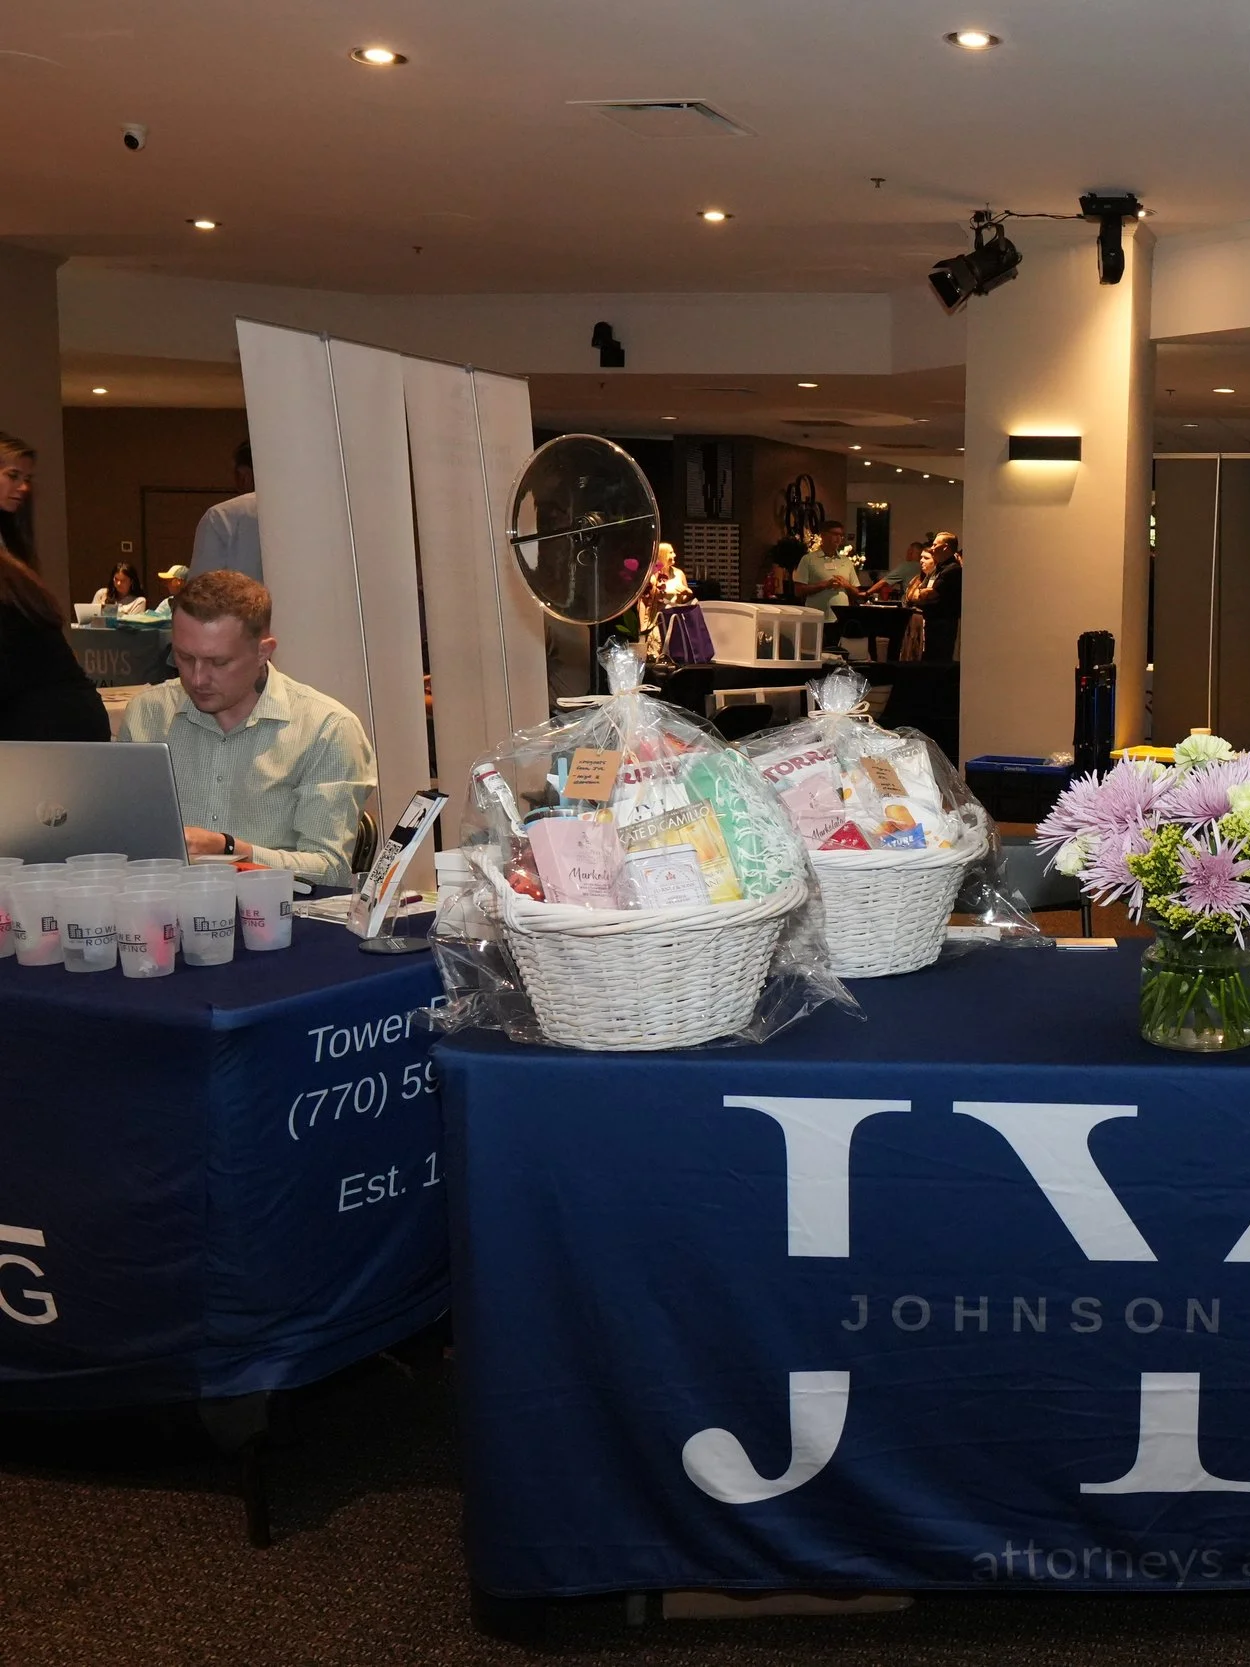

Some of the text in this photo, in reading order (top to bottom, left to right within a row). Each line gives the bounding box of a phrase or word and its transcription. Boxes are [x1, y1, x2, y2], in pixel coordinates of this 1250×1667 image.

[84, 649, 132, 676] GUYS
[307, 1009, 415, 1063] Tower
[288, 1060, 440, 1141] (770) 59
[337, 1164, 407, 1213] Est.
[841, 1293, 1221, 1334] JOHNSON
[972, 1538, 1224, 1587] attorneys
